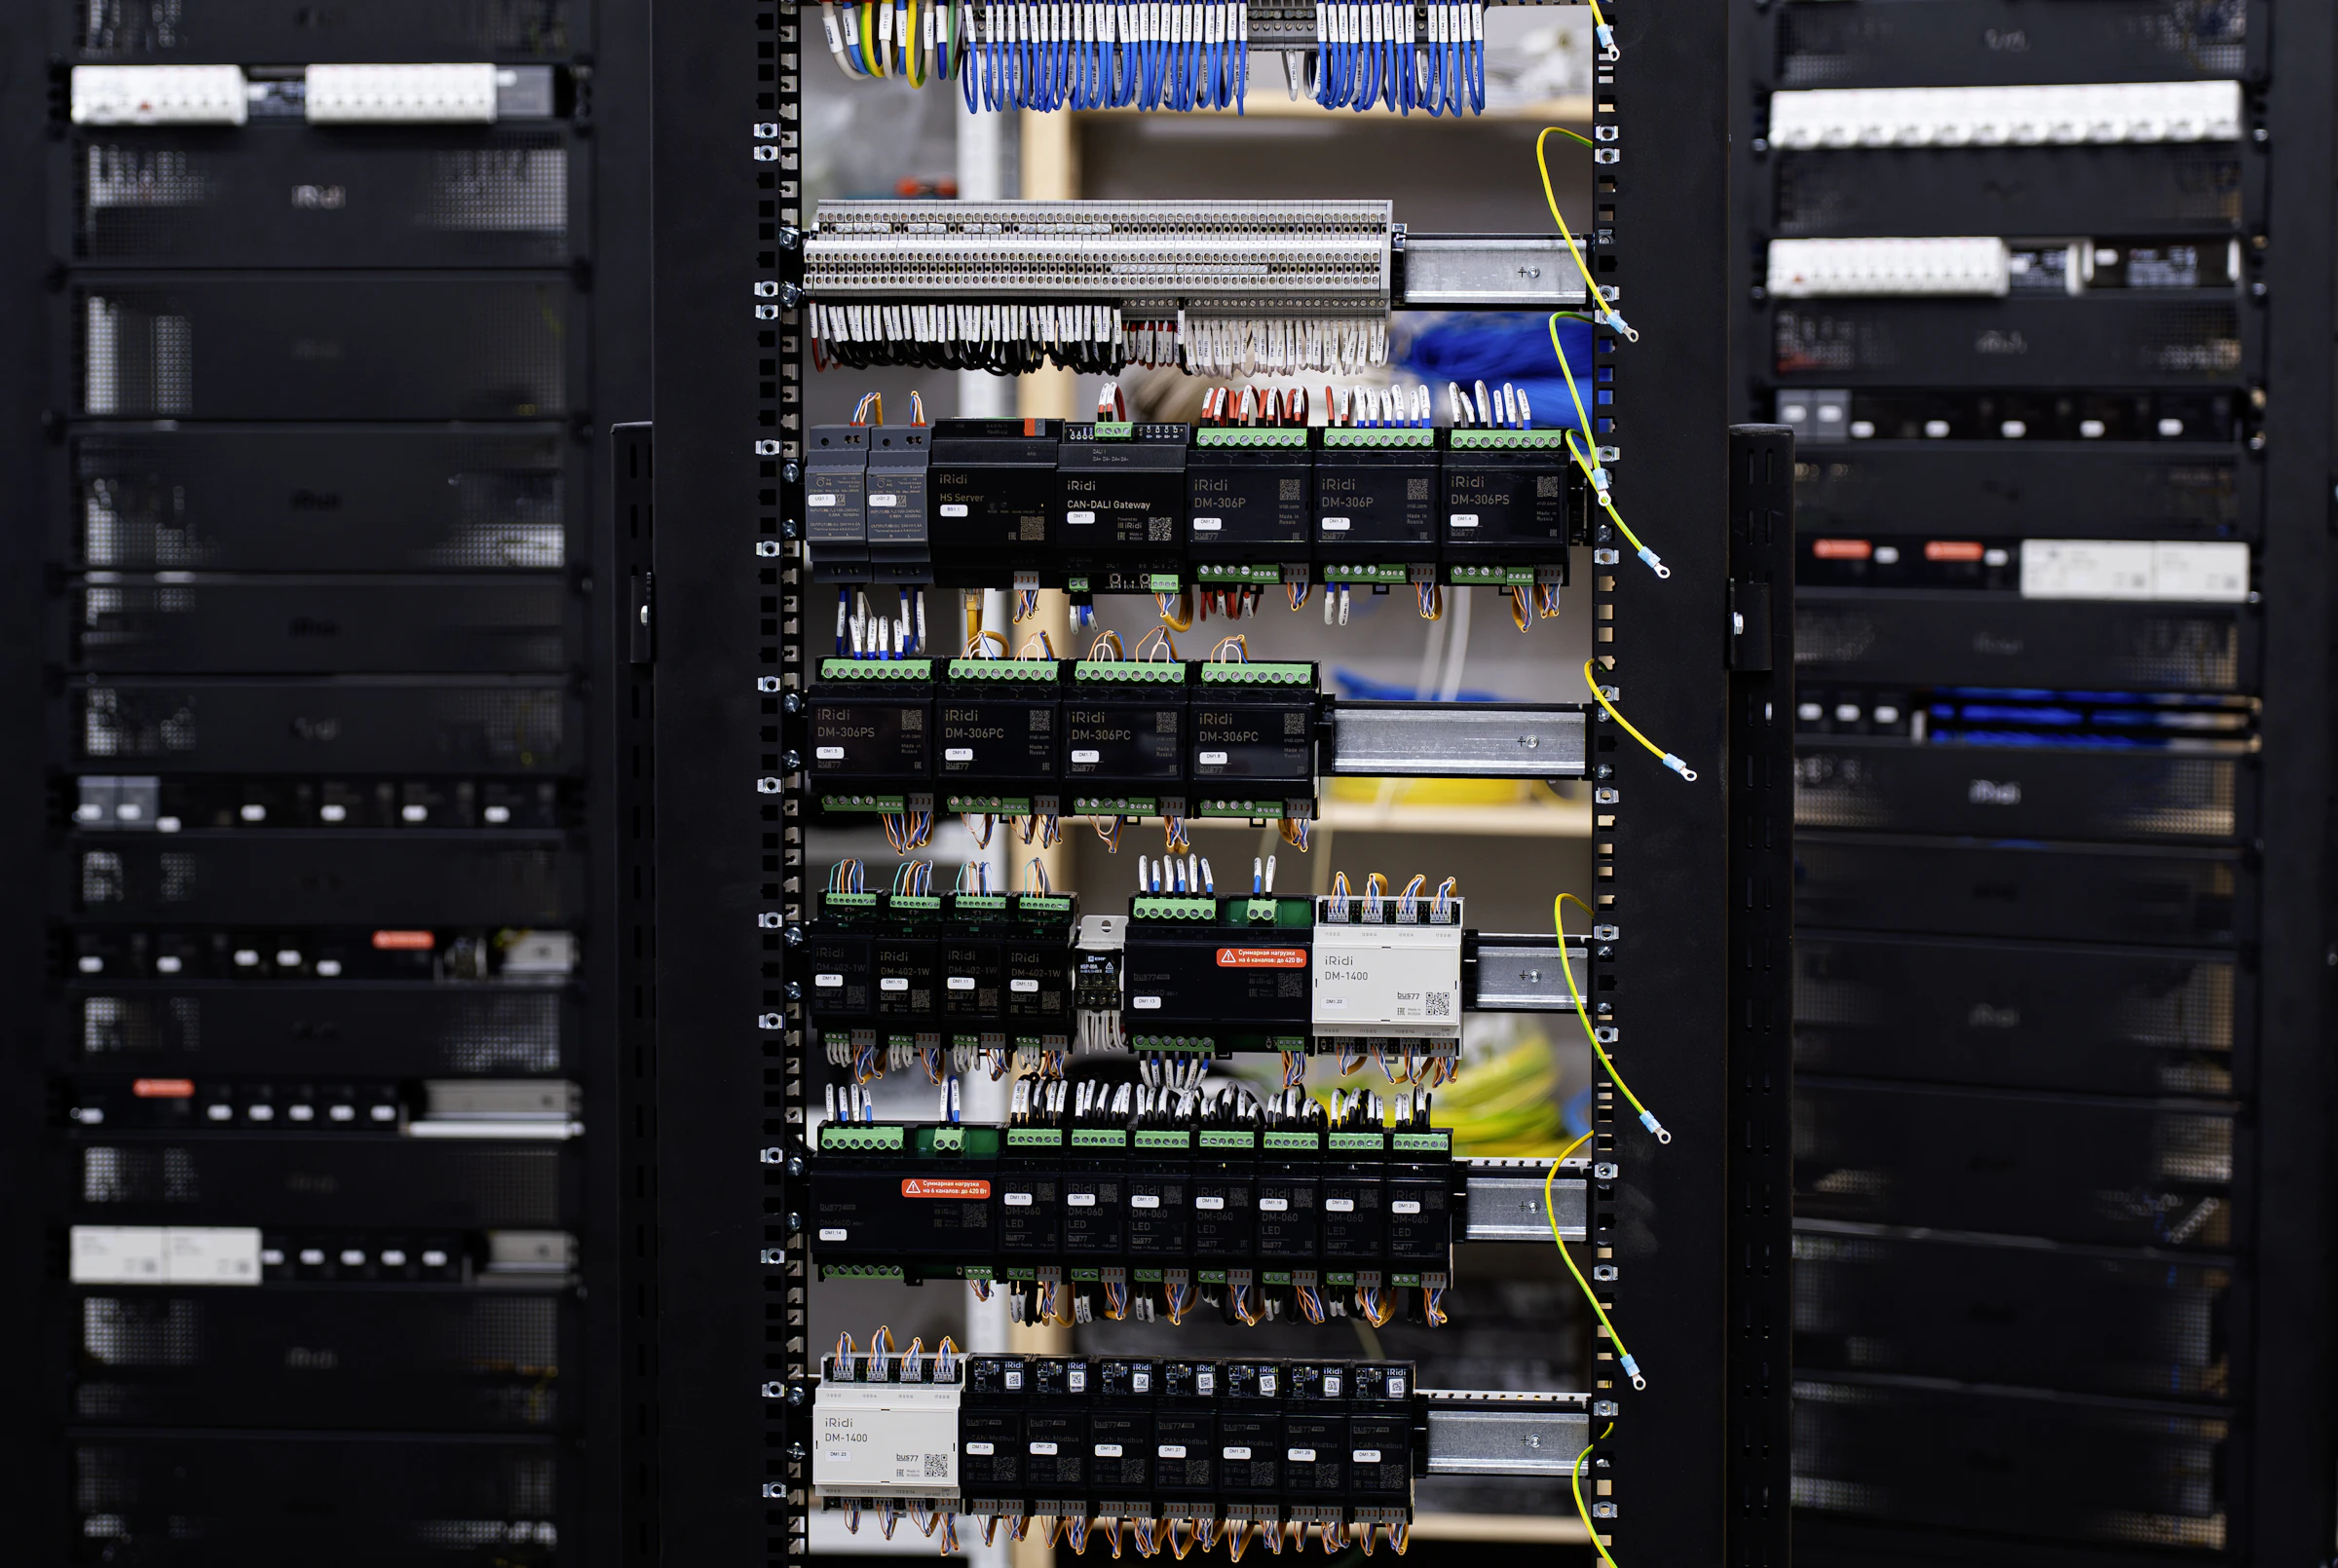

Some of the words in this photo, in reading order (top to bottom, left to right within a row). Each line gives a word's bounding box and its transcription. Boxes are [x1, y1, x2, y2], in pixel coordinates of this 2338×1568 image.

[939, 473, 966, 484] iRidi
[1452, 475, 1485, 487] iRidi
[1068, 480, 1096, 491] iRidi
[1194, 479, 1227, 491] iRidi
[1322, 479, 1355, 491] iRidi
[939, 493, 953, 503] HS
[955, 493, 984, 503] Server
[1194, 497, 1246, 508] DM-306P
[1322, 497, 1374, 508] DM-306P
[1452, 495, 1510, 504] DM-306PS
[1112, 501, 1151, 510] Gateway
[817, 709, 849, 721] iRidi
[945, 709, 978, 722] iRidi
[1072, 711, 1105, 724] iRidi
[1199, 713, 1233, 725] iRidi
[817, 727, 875, 738] DM-306PS
[945, 727, 1004, 738] DM-306PC
[1072, 730, 1131, 740] DM-306PC
[1199, 730, 1259, 742] DM-306PC
[816, 947, 844, 958] iRidi
[881, 951, 908, 962] iRidi
[948, 951, 976, 960] iRidi
[1011, 952, 1039, 963] iRidi
[1325, 956, 1354, 966] iRidi
[816, 963, 866, 972] DM-402-1W
[881, 967, 930, 976] DM-402-1W
[1011, 968, 1061, 978] DM-402-1W
[1325, 971, 1368, 981] DM-1400
[1005, 1182, 1033, 1192] iRidi
[1068, 1183, 1096, 1192] iRidi
[1132, 1184, 1160, 1195] iRidi
[1198, 1187, 1226, 1196] iRidi
[1262, 1188, 1290, 1198] iRidi
[1327, 1188, 1356, 1198] iRidi
[1393, 1190, 1421, 1200] iRidi
[1197, 1212, 1233, 1221] DM-060
[1327, 1213, 1364, 1222] DM-060
[1068, 1220, 1087, 1229] LED
[1132, 1222, 1150, 1231] LED
[1262, 1226, 1280, 1235] LED
[1393, 1228, 1412, 1237] LED
[825, 1418, 853, 1428] iRidi
[825, 1434, 868, 1442] DM-1400
[896, 1453, 919, 1462] bus77
